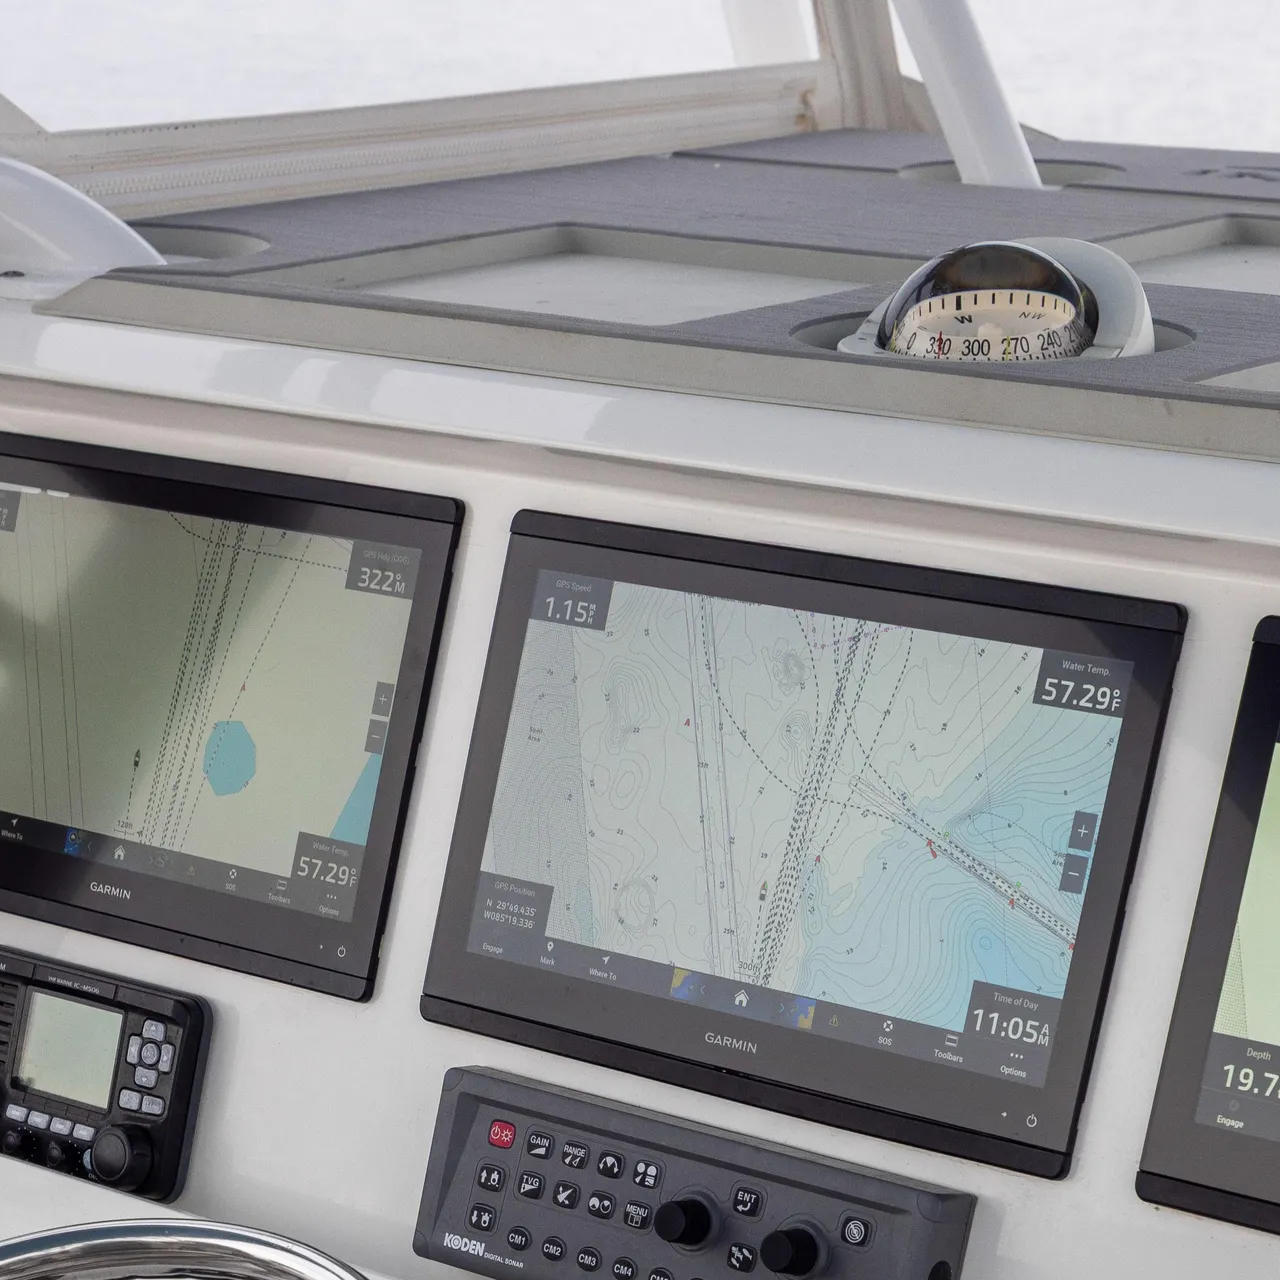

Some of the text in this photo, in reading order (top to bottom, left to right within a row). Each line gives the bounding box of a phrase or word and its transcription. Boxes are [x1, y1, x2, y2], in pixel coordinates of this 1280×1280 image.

[962, 338, 991, 357] 300
[1001, 335, 1030, 355] 270
[1037, 329, 1062, 350] 240
[357, 566, 394, 592] 322
[555, 579, 592, 594] GPS Speed
[545, 596, 588, 623] 1.15
[1062, 659, 1111, 677] Water Temp.
[1041, 677, 1111, 710] 57.29
[296, 856, 350, 886] 57.29
[89, 881, 131, 900] GARMIN
[494, 881, 536, 898] GPS Position
[486, 898, 493, 908] N
[482, 941, 504, 955] Engage
[539, 955, 556, 967] Mark
[589, 966, 617, 981] Where To
[993, 991, 1039, 1011] Time of Day
[972, 1008, 1039, 1044] 11:05
[704, 1032, 758, 1055] GARMIN
[877, 1035, 893, 1046] SOS
[934, 1048, 964, 1064] Toolbars
[1245, 1047, 1272, 1062] Depth
[999, 1063, 1027, 1079] Options
[1222, 1062, 1278, 1098] 19.7
[1216, 1113, 1245, 1130] Engage
[529, 1134, 550, 1148] GAIN
[563, 1143, 587, 1158] RANGE
[522, 1174, 540, 1187] TVG
[737, 1190, 757, 1204] ENT
[625, 1203, 649, 1217] MENU
[508, 1233, 527, 1247] CM1
[443, 1232, 524, 1269] KODEN DIGITAL SONAR
[543, 1242, 562, 1257] CM2
[578, 1253, 597, 1267] CM3
[613, 1263, 633, 1278] CM4
